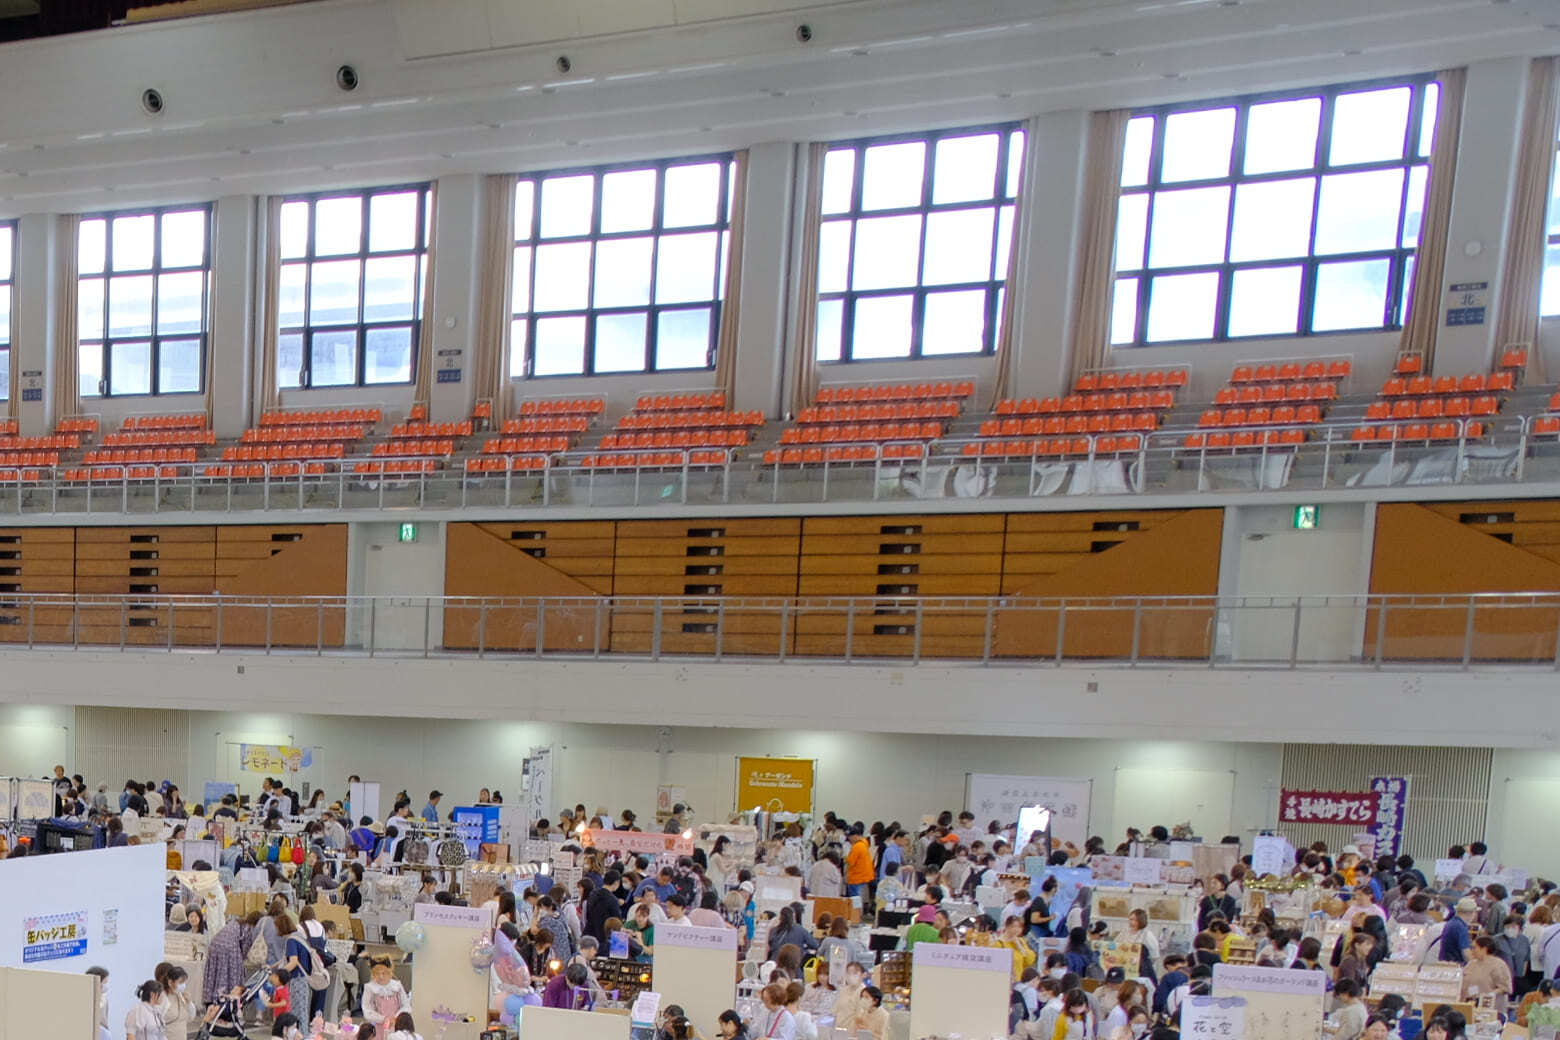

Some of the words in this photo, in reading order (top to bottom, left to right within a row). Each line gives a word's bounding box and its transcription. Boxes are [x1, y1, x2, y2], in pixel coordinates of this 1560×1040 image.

[1298, 797, 1372, 821] 長崎かすてら
[27, 924, 77, 944] 缶バッジ工房
